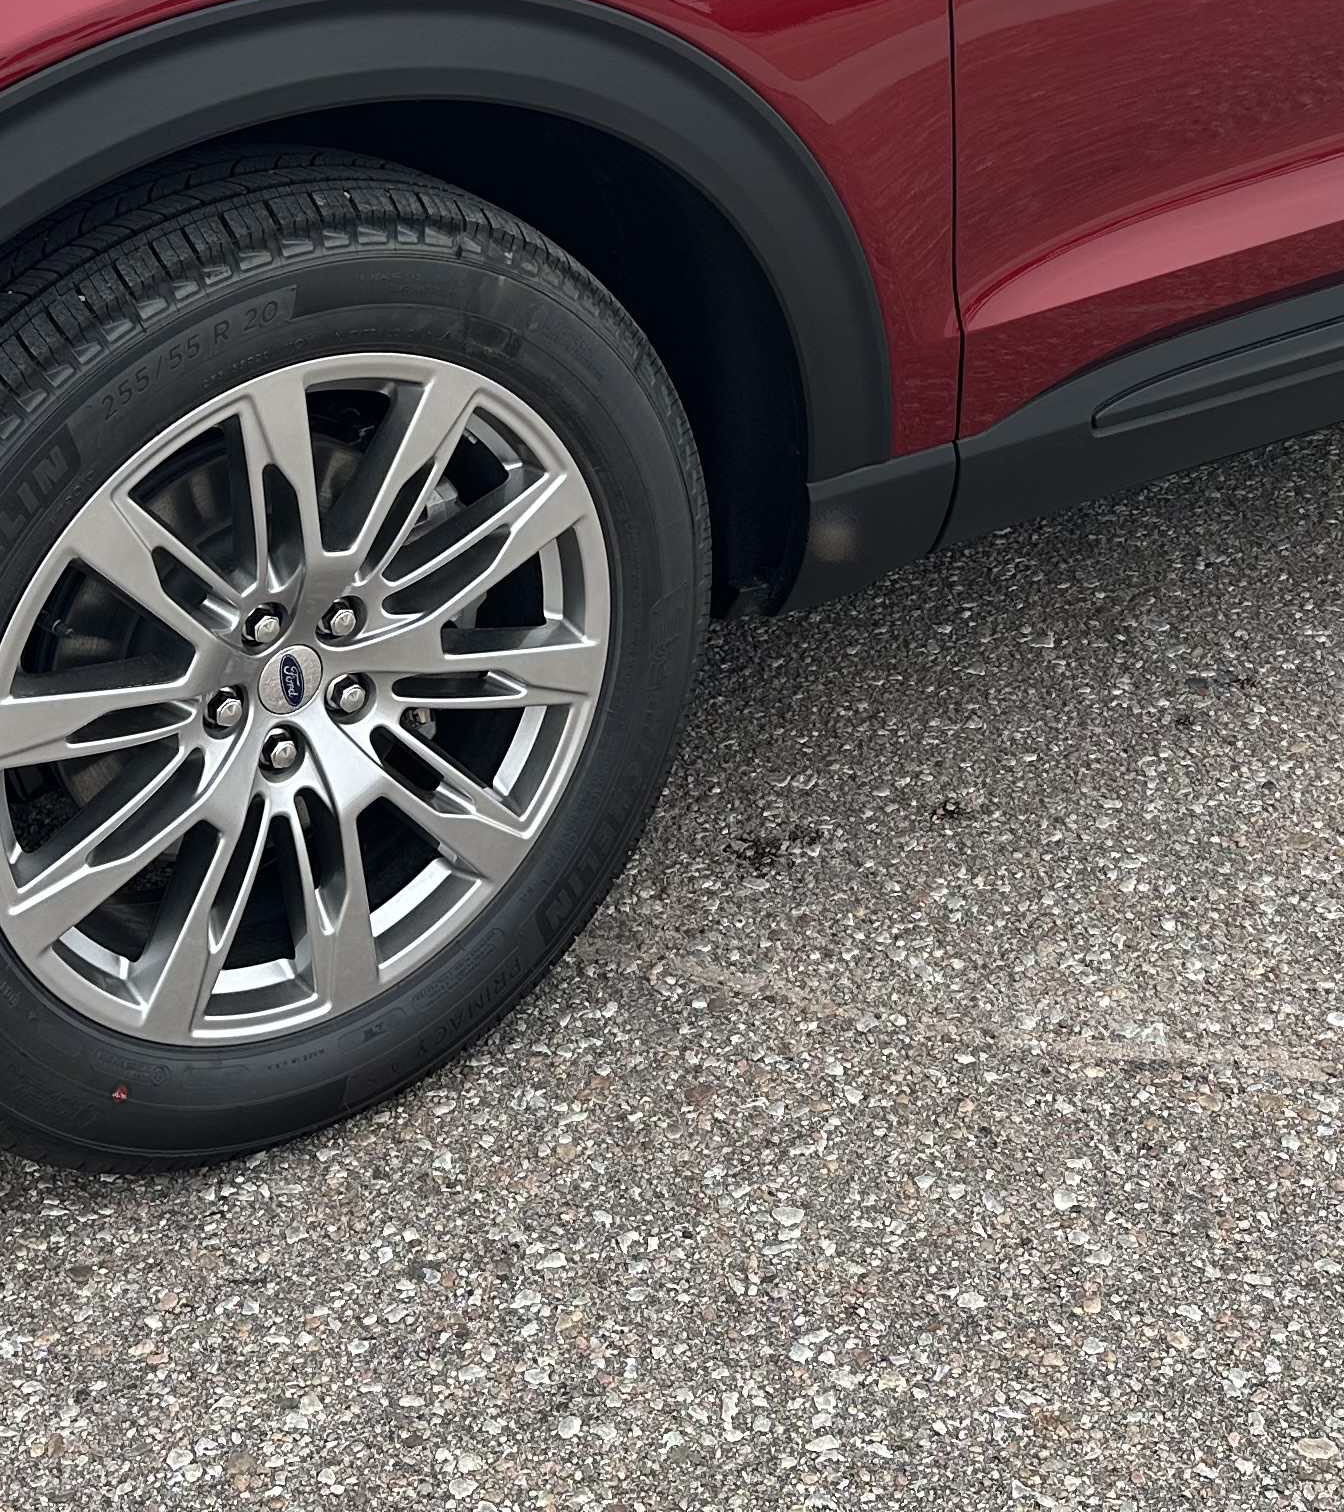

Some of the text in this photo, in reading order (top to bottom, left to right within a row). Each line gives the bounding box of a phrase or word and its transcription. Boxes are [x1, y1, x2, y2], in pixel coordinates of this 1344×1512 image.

[100, 333, 201, 421] 255/55
[213, 319, 230, 345] R
[243, 300, 279, 332] 20
[283, 665, 301, 698] Ford
